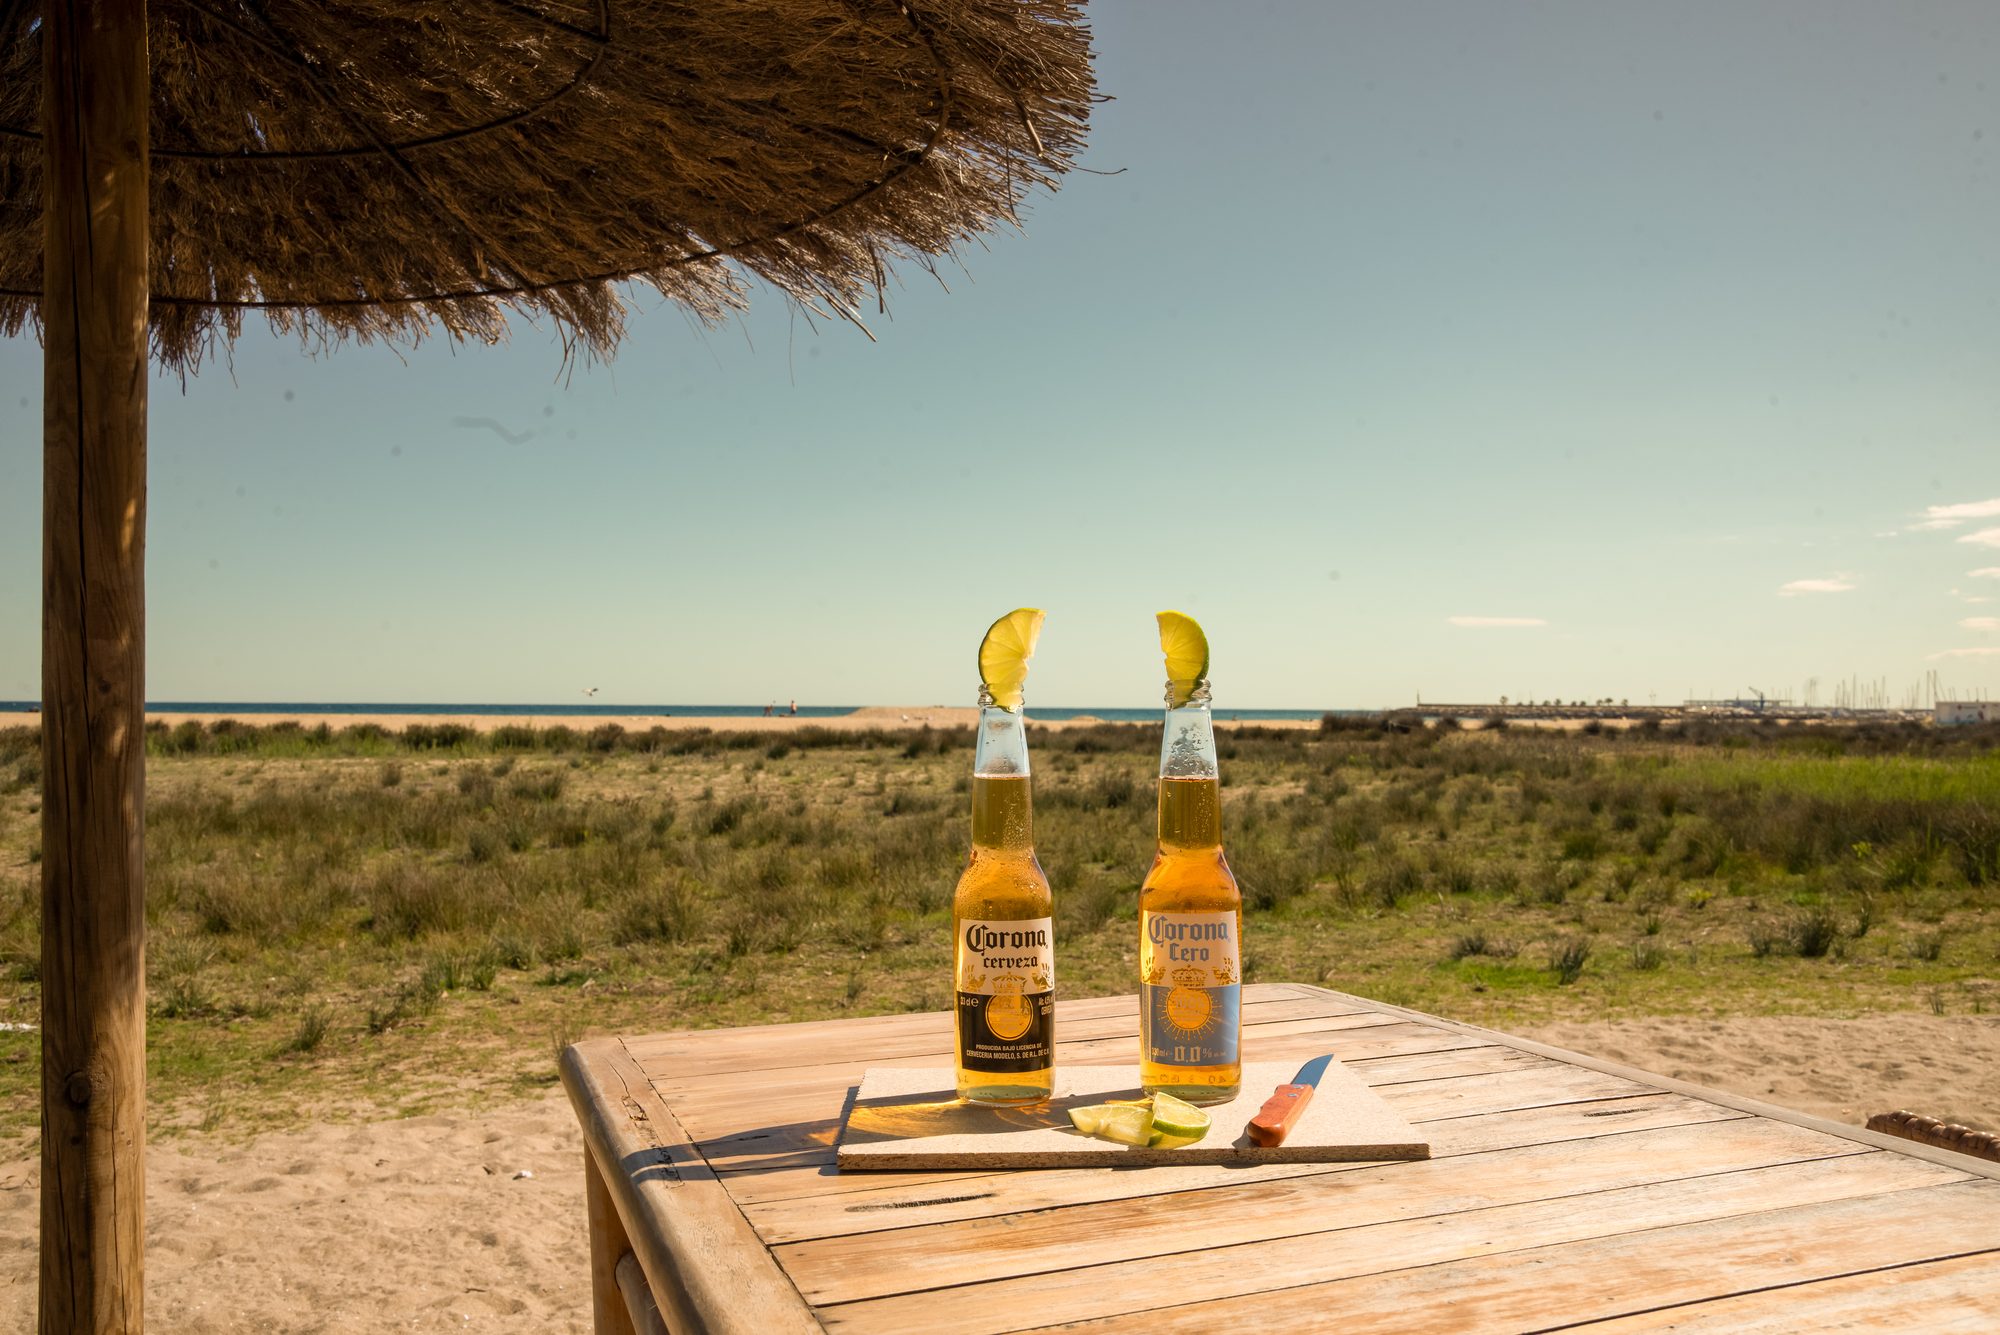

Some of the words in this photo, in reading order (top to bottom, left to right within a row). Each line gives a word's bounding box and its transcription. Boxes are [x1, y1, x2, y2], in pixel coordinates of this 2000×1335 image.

[966, 924, 1047, 957] Corona
[1148, 915, 1229, 948] Corona
[1169, 943, 1210, 962] Cero
[983, 956, 1039, 969] cerveza
[975, 1043, 1002, 1051] PRODUCIDA
[1016, 1043, 1036, 1051] LICENCIA
